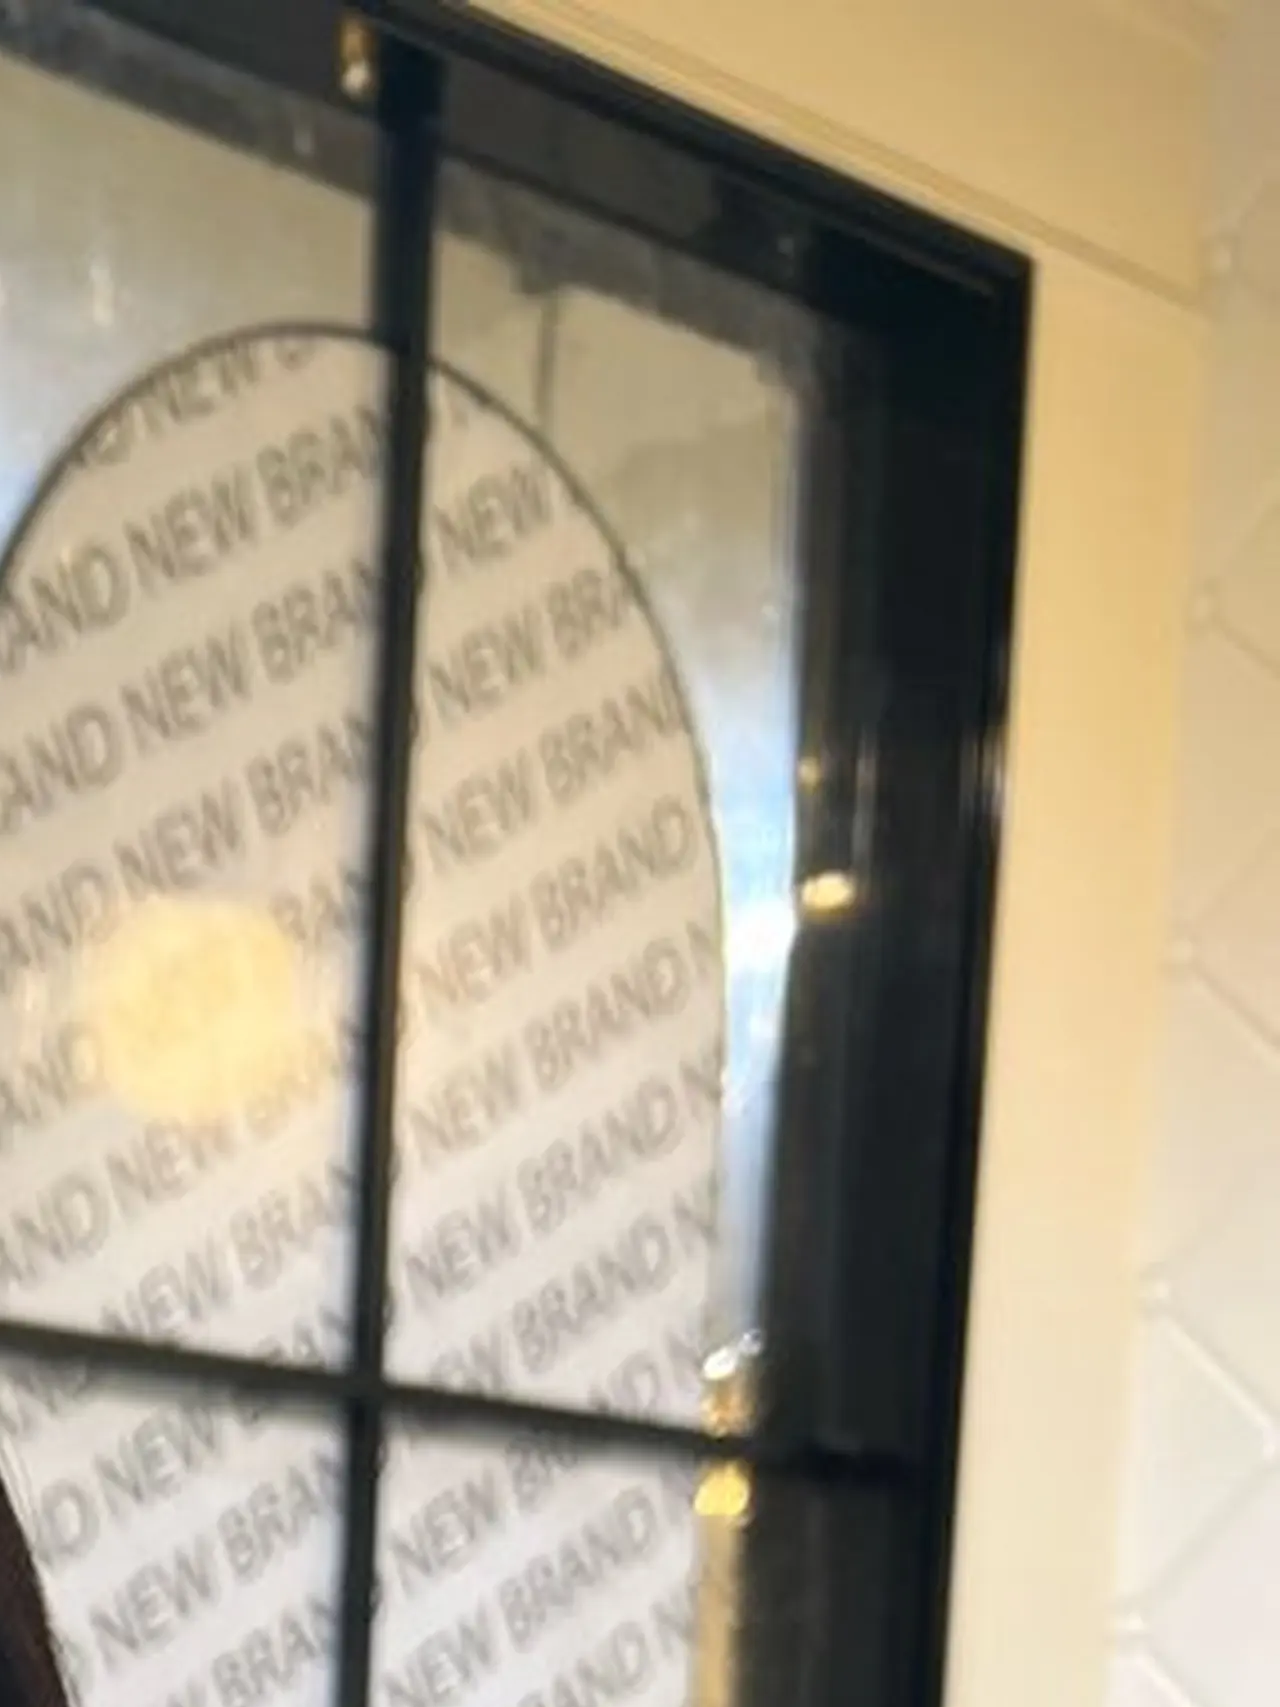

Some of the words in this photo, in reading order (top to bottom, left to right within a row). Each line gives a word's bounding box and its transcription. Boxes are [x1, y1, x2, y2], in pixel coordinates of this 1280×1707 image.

[120, 624, 251, 755] NEW
[434, 461, 553, 578] NEW
[124, 465, 260, 594] NEW
[113, 777, 247, 896] NEW
[428, 600, 545, 730] NEW
[421, 744, 533, 873] NEW
[414, 890, 535, 1030] NEW
[530, 794, 697, 952] BRAND
[408, 1034, 526, 1170] NEW
[524, 936, 690, 1092] BRAND
[94, 1398, 234, 1518] NEW
[405, 1182, 522, 1306] NEW
[517, 1075, 683, 1233] BRAND
[90, 1535, 220, 1676] NEW
[512, 1214, 674, 1375] BRAND
[391, 1462, 508, 1599] NEW
[498, 1486, 658, 1654] BRAND
